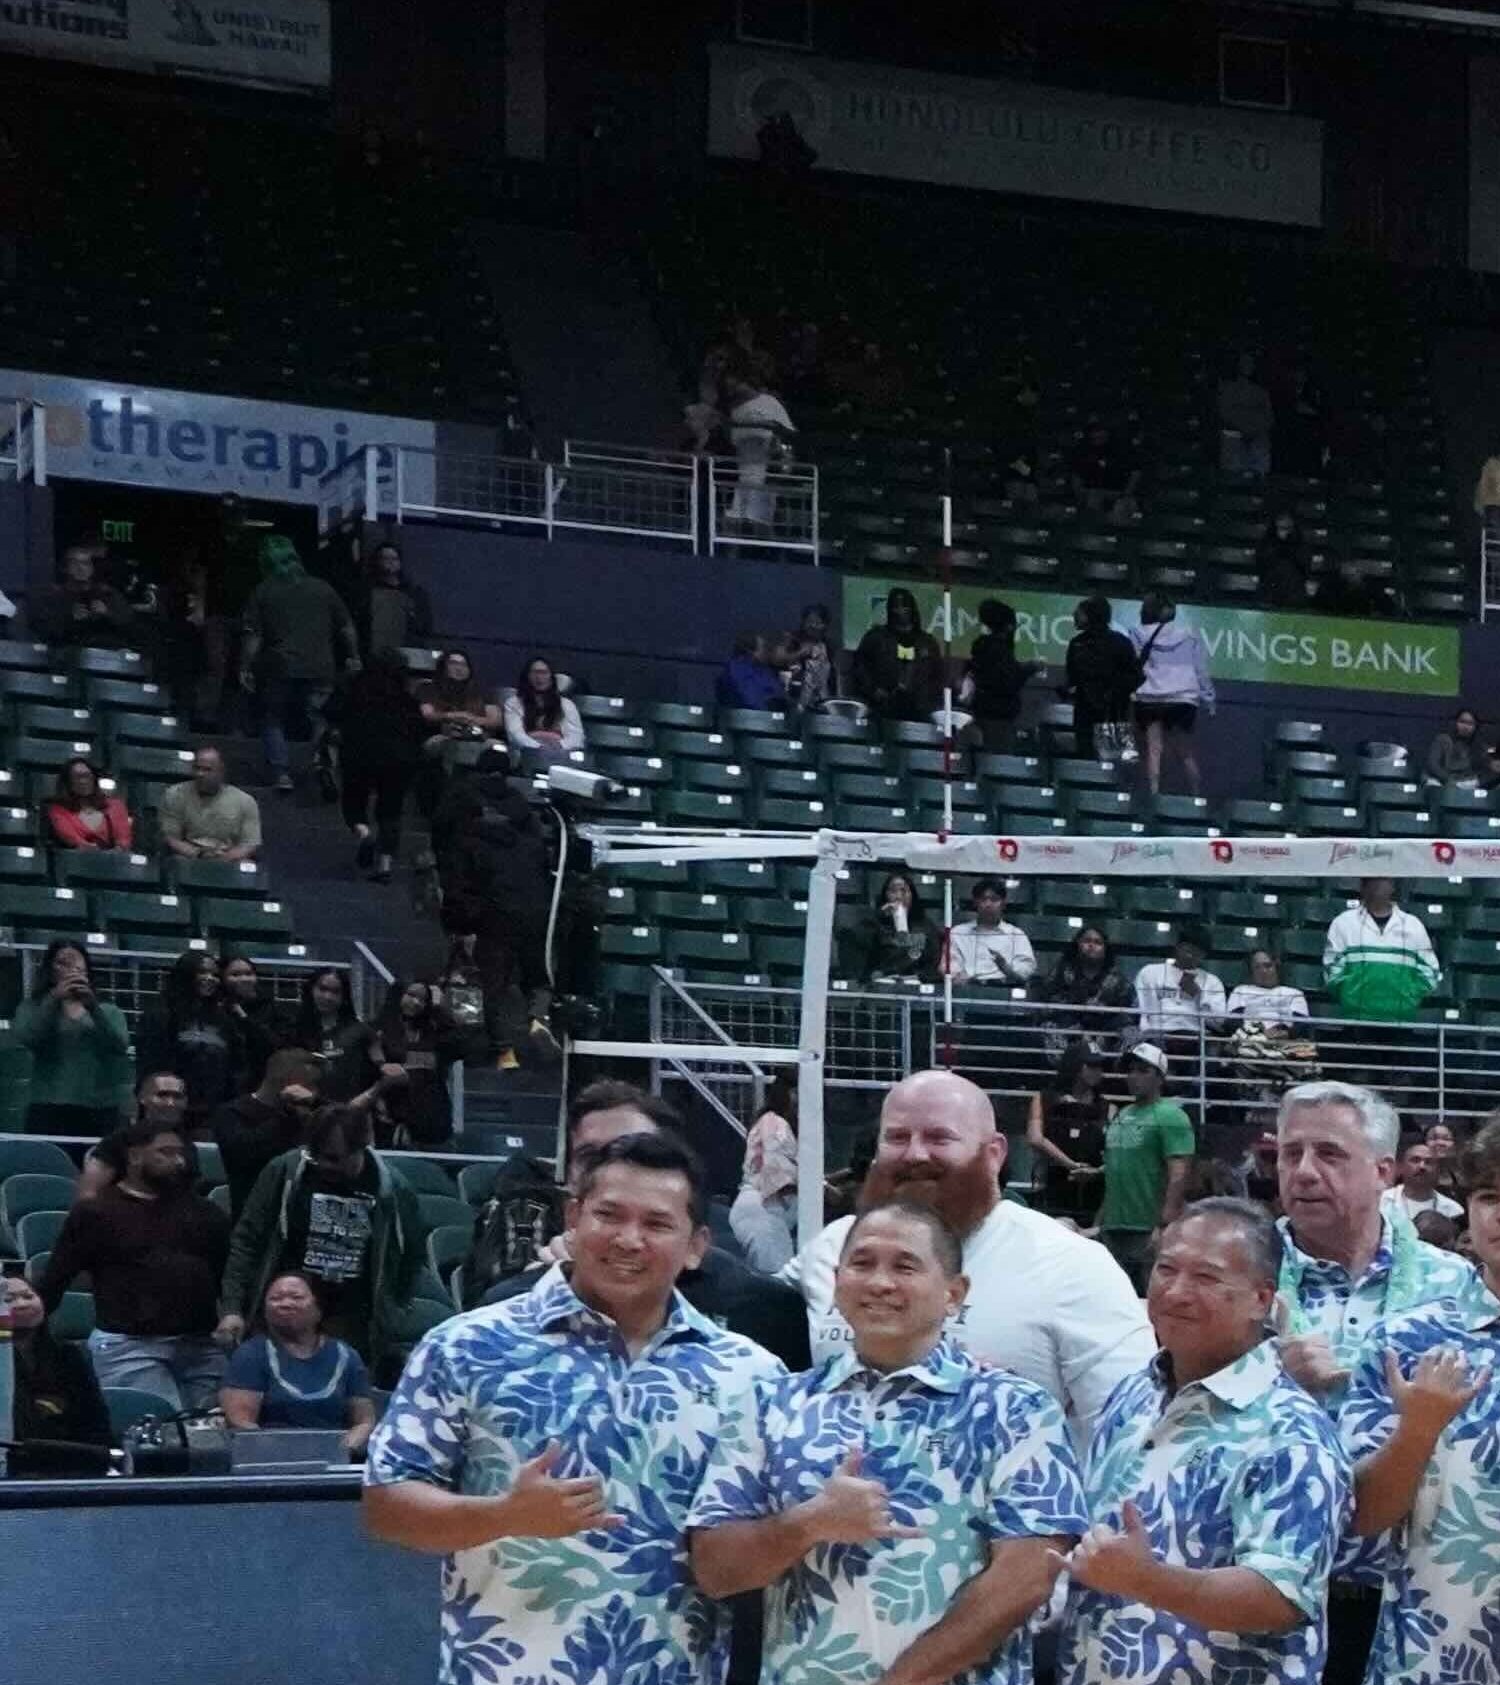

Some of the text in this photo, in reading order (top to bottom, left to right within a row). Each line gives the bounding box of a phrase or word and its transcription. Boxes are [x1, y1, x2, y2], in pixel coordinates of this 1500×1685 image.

[849, 93, 1062, 147] HONOLULU
[1076, 117, 1208, 164] COFFEE
[103, 520, 136, 543] EXIT
[1332, 638, 1438, 676] BANK
